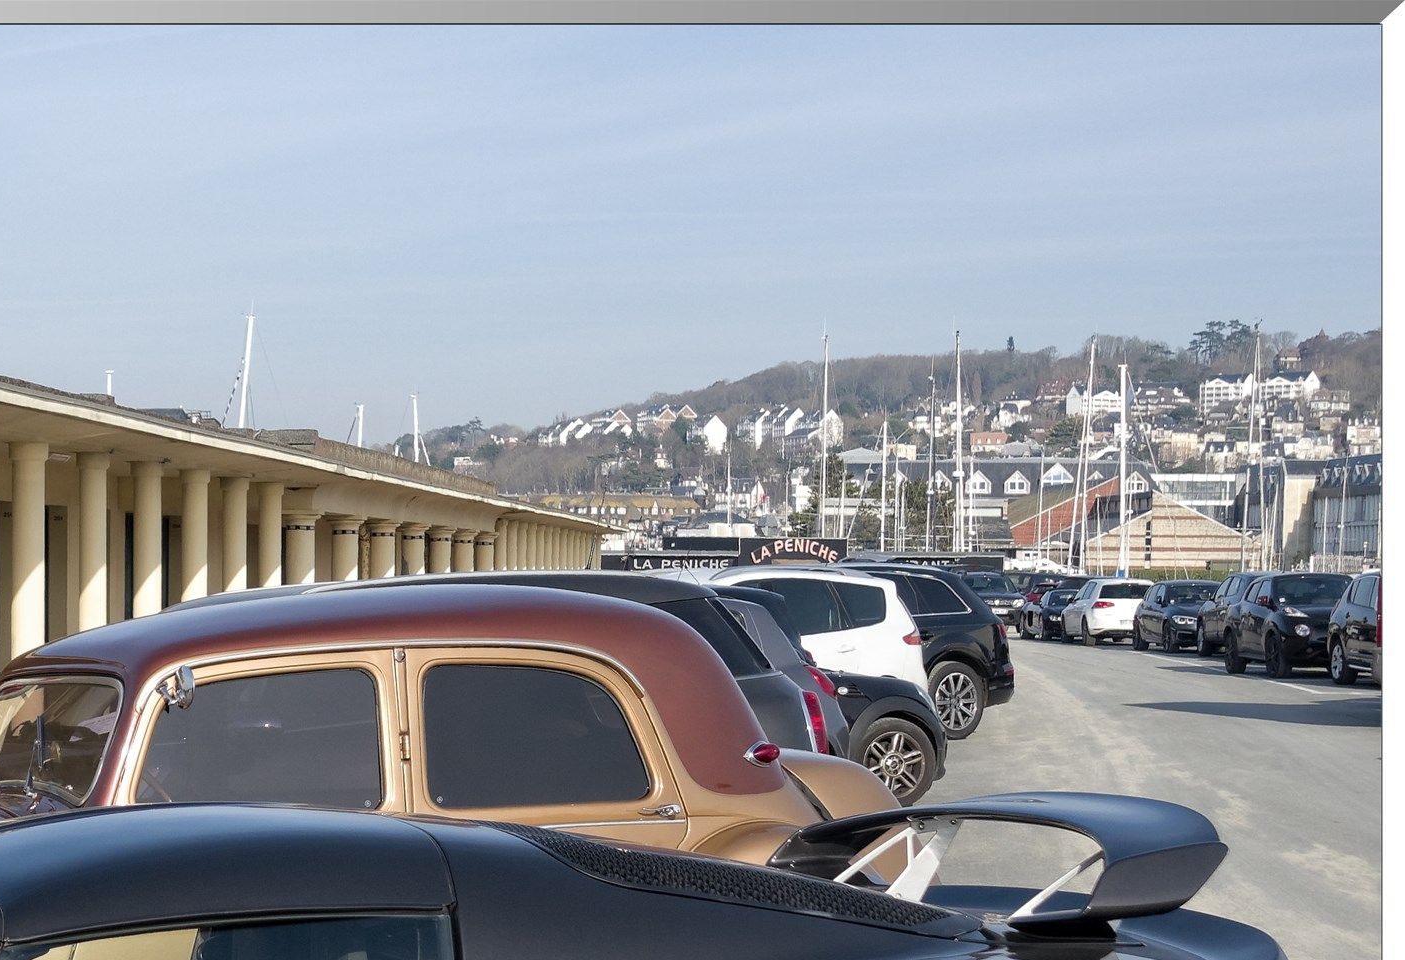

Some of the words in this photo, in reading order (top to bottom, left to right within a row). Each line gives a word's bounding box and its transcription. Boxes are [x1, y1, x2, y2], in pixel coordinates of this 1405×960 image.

[750, 545, 772, 565] LA
[773, 538, 839, 565] PENICHE
[633, 559, 652, 570] LA
[660, 559, 730, 570] PENICHE
